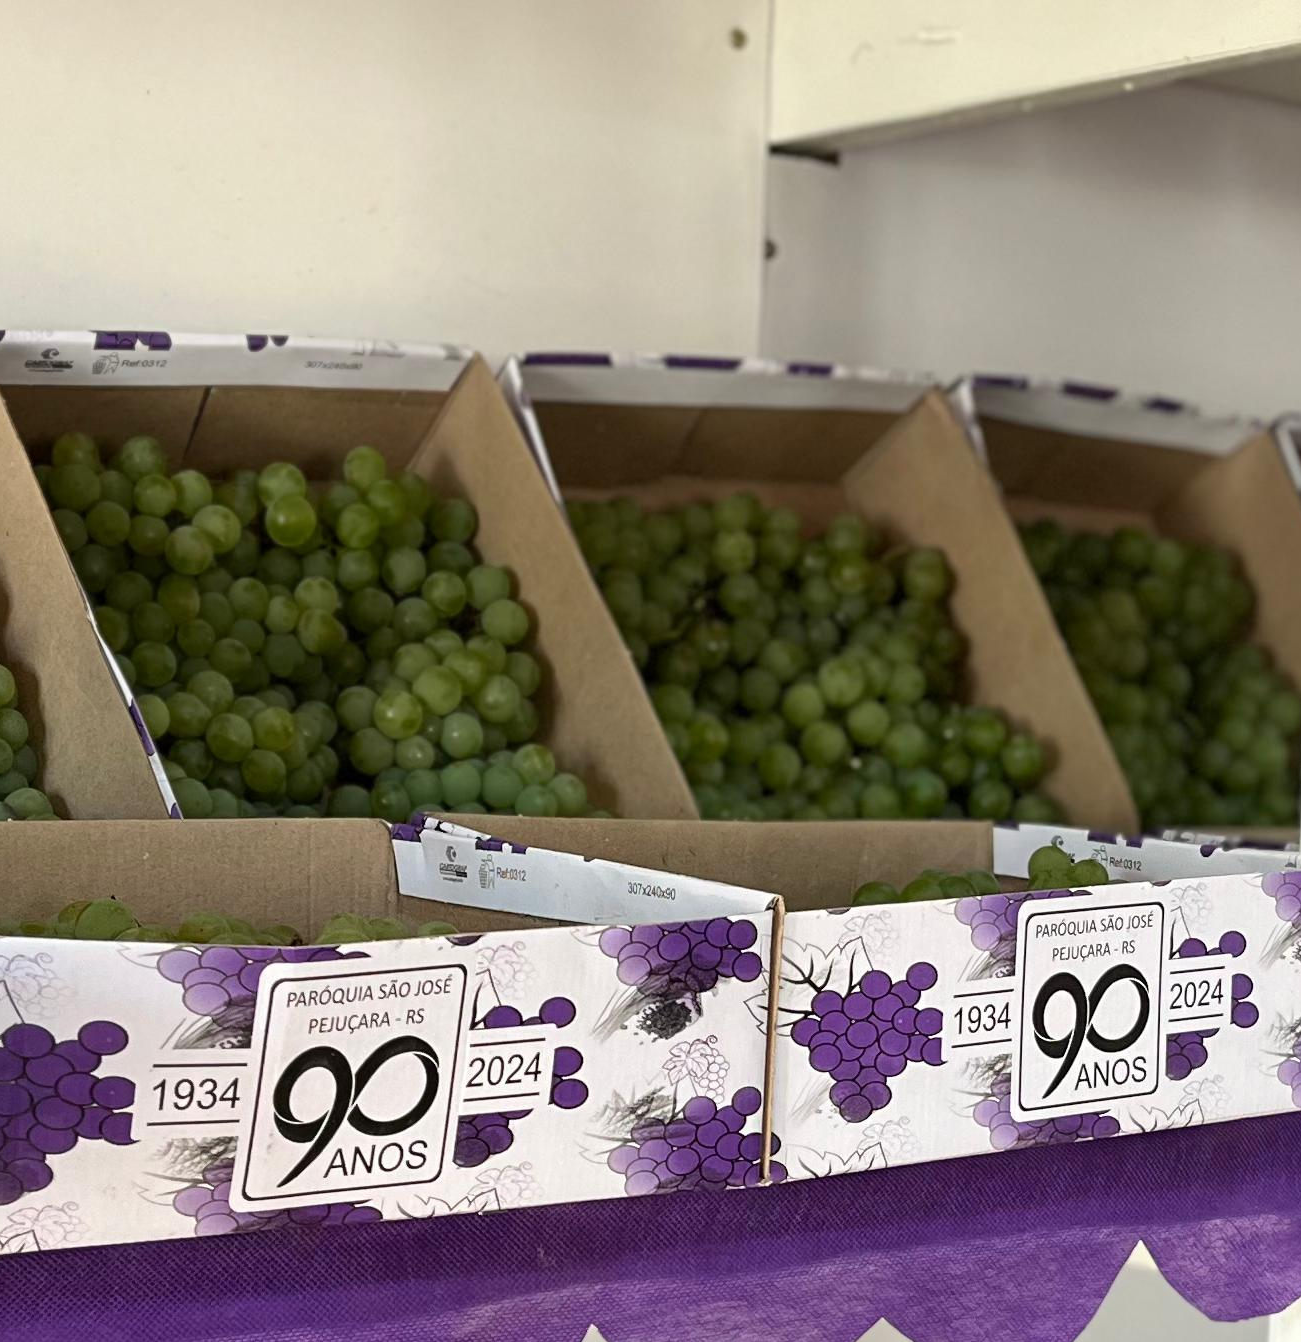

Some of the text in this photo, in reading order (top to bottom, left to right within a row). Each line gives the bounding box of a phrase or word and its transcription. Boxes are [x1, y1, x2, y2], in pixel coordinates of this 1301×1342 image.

[496, 866, 527, 882] Ref:0312
[627, 881, 676, 901] 307x240x90
[1035, 911, 1154, 938] PARÓQUIA SÃO JOSÉ
[1052, 941, 1111, 962] PEJUÇARA
[1122, 939, 1136, 954] RS
[286, 973, 453, 1008] PARÓQUIA SÃO JOSÉ
[1169, 978, 1224, 1010] 2024
[308, 1012, 391, 1034] PEJUÇARA
[405, 1007, 425, 1025] RS
[954, 1001, 1011, 1034] 1934
[1032, 964, 1150, 1099] 90
[466, 1052, 542, 1088] 2024
[1074, 1056, 1147, 1091] ANOS
[152, 1078, 240, 1112] 1934
[273, 1035, 439, 1188] 90
[323, 1139, 427, 1179] ANOS
